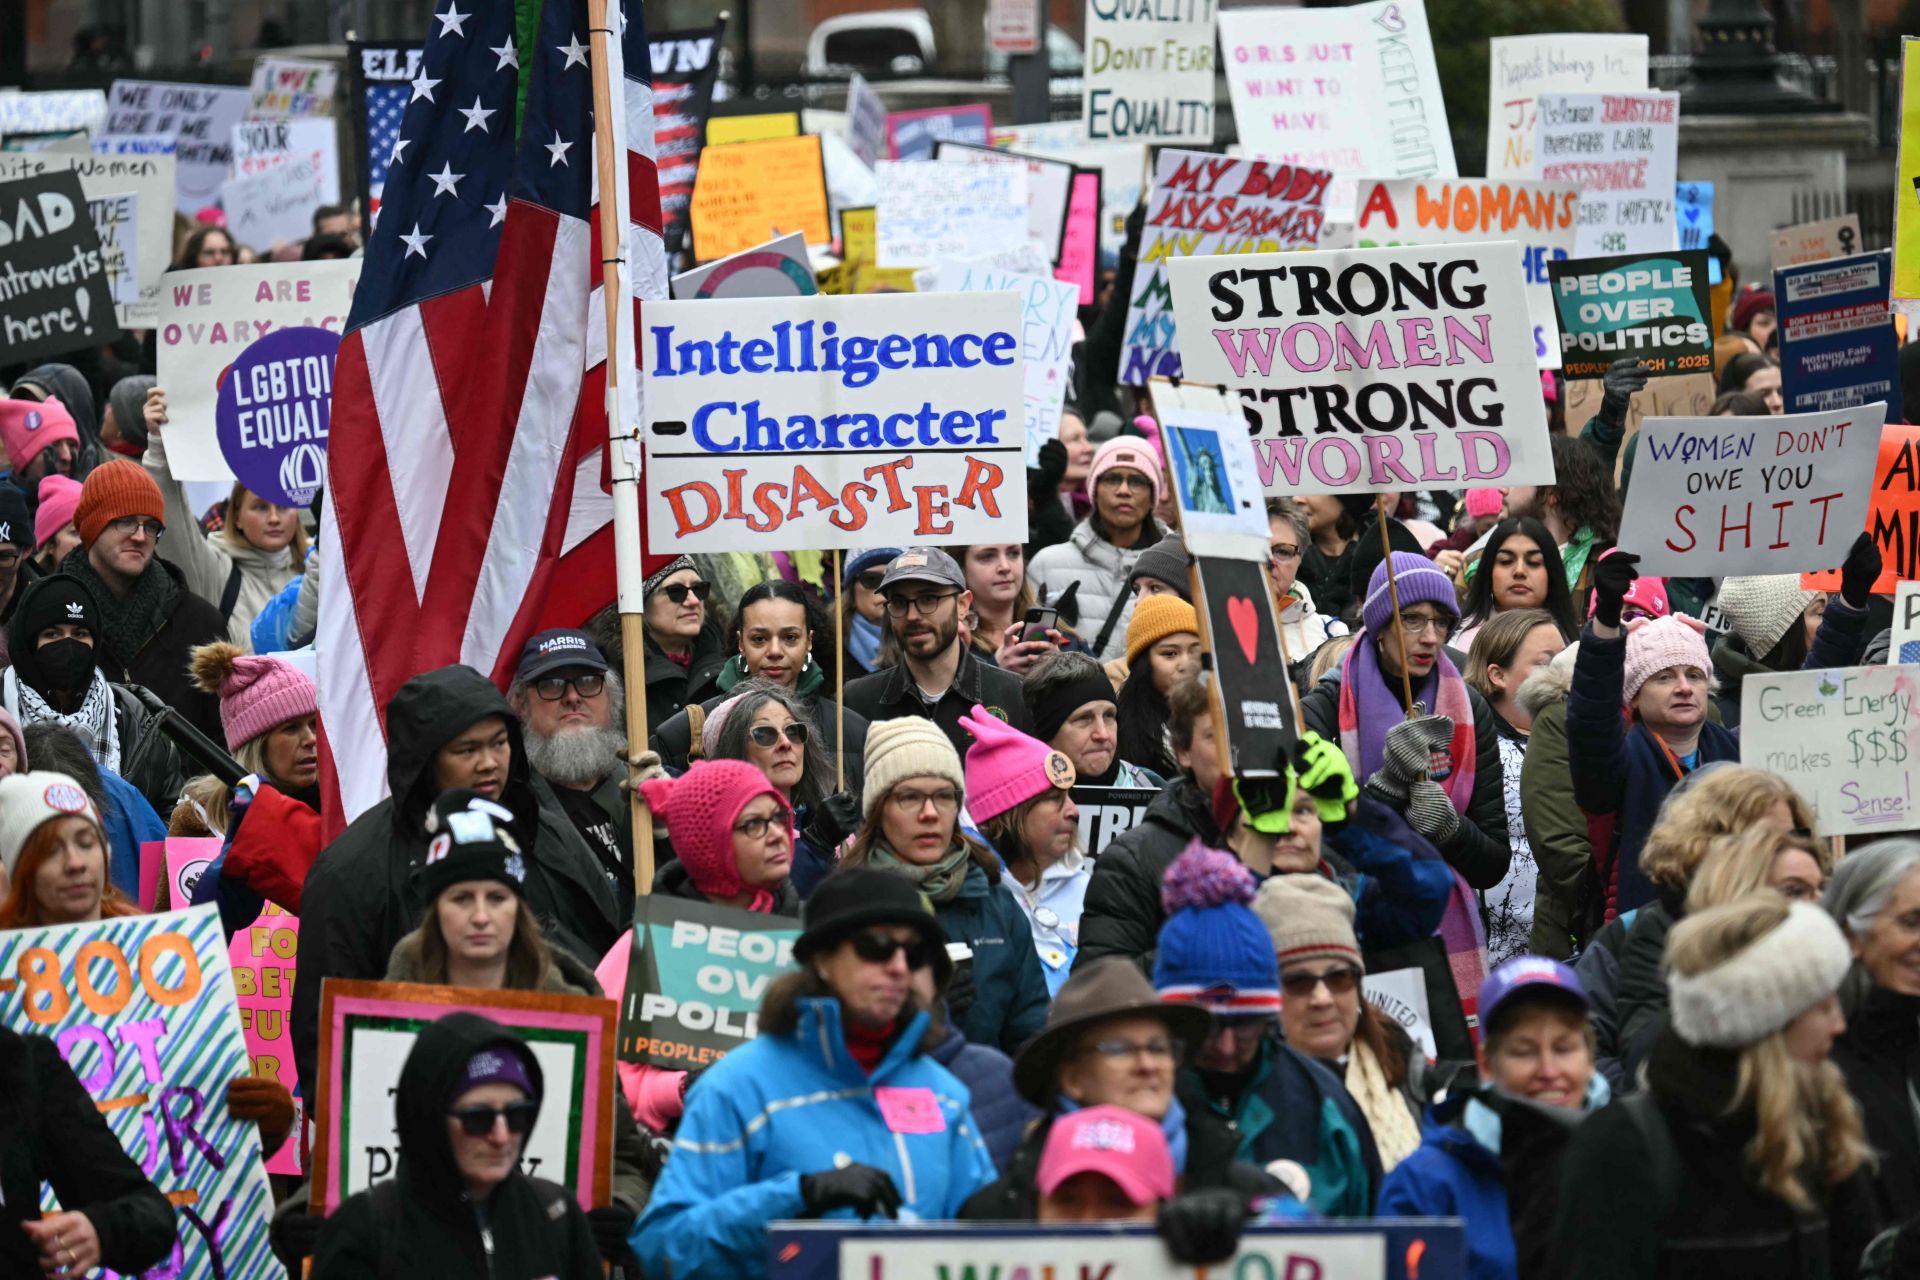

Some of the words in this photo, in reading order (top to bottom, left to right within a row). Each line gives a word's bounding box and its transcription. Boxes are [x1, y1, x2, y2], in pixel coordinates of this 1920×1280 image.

[1092, 37, 1157, 75] DONT
[1162, 39, 1214, 72] FEAR
[1235, 45, 1297, 64] GIRLS
[1305, 43, 1354, 62] JUST
[1377, 33, 1419, 94] KEEP
[1245, 79, 1304, 97] WANT
[1314, 79, 1341, 96] TO
[1088, 88, 1214, 139] EQUALITY
[1272, 113, 1330, 130] HAVE
[71, 157, 157, 178] Women
[1163, 155, 1240, 193] MY
[1237, 160, 1333, 206] BODY
[1359, 182, 1399, 230] A
[1415, 183, 1577, 234] WOMAN'S
[1142, 230, 1206, 265] MY
[1209, 259, 1487, 322] STRONG
[1560, 266, 1693, 297] PEOPLE
[1815, 270, 1849, 281] Trump's
[1851, 264, 1877, 274] Wives
[174, 283, 212, 307] WE
[255, 280, 311, 303] ARE
[1579, 297, 1675, 324] OVER
[4, 286, 93, 346] here!
[1788, 315, 1812, 327] DON'T
[1812, 312, 1832, 324] PRAY
[1833, 311, 1841, 320] IN
[1842, 309, 1854, 319] MY
[1855, 304, 1886, 316] SCHOOL
[651, 320, 1017, 389] Intelligence
[1212, 314, 1494, 377] WOMEN
[1560, 322, 1709, 353] POLITICS
[1677, 354, 1711, 369] 2025
[1801, 350, 1845, 366] Nothing
[1808, 361, 1830, 373] Like
[1831, 355, 1867, 369] Prayer
[234, 354, 338, 406] LGBTQI
[1812, 393, 1828, 404] YOU
[1832, 391, 1848, 401] ARE
[238, 398, 332, 450] EQUAL
[1240, 376, 1505, 439] STRONG
[1250, 429, 1512, 488] WORLD
[1648, 432, 1756, 464] WOMEN
[1776, 421, 1852, 457] DON'T
[661, 454, 1004, 540] DISASTER
[1687, 467, 1744, 495] OWE
[1760, 463, 1814, 494] YOU
[1665, 492, 1844, 554] SHIT
[539, 636, 587, 652] HARRIS
[1759, 686, 1826, 722] Green
[1843, 676, 1912, 727] Energy
[1765, 746, 1832, 773] makes
[1847, 726, 1908, 769] $$$
[1108, 792, 1141, 800] POWERED
[1840, 770, 1912, 815] Sense!
[250, 926, 298, 960] FO
[696, 964, 770, 1001] OV
[640, 993, 758, 1040] POLI
[1366, 989, 1418, 1029] UNITED
